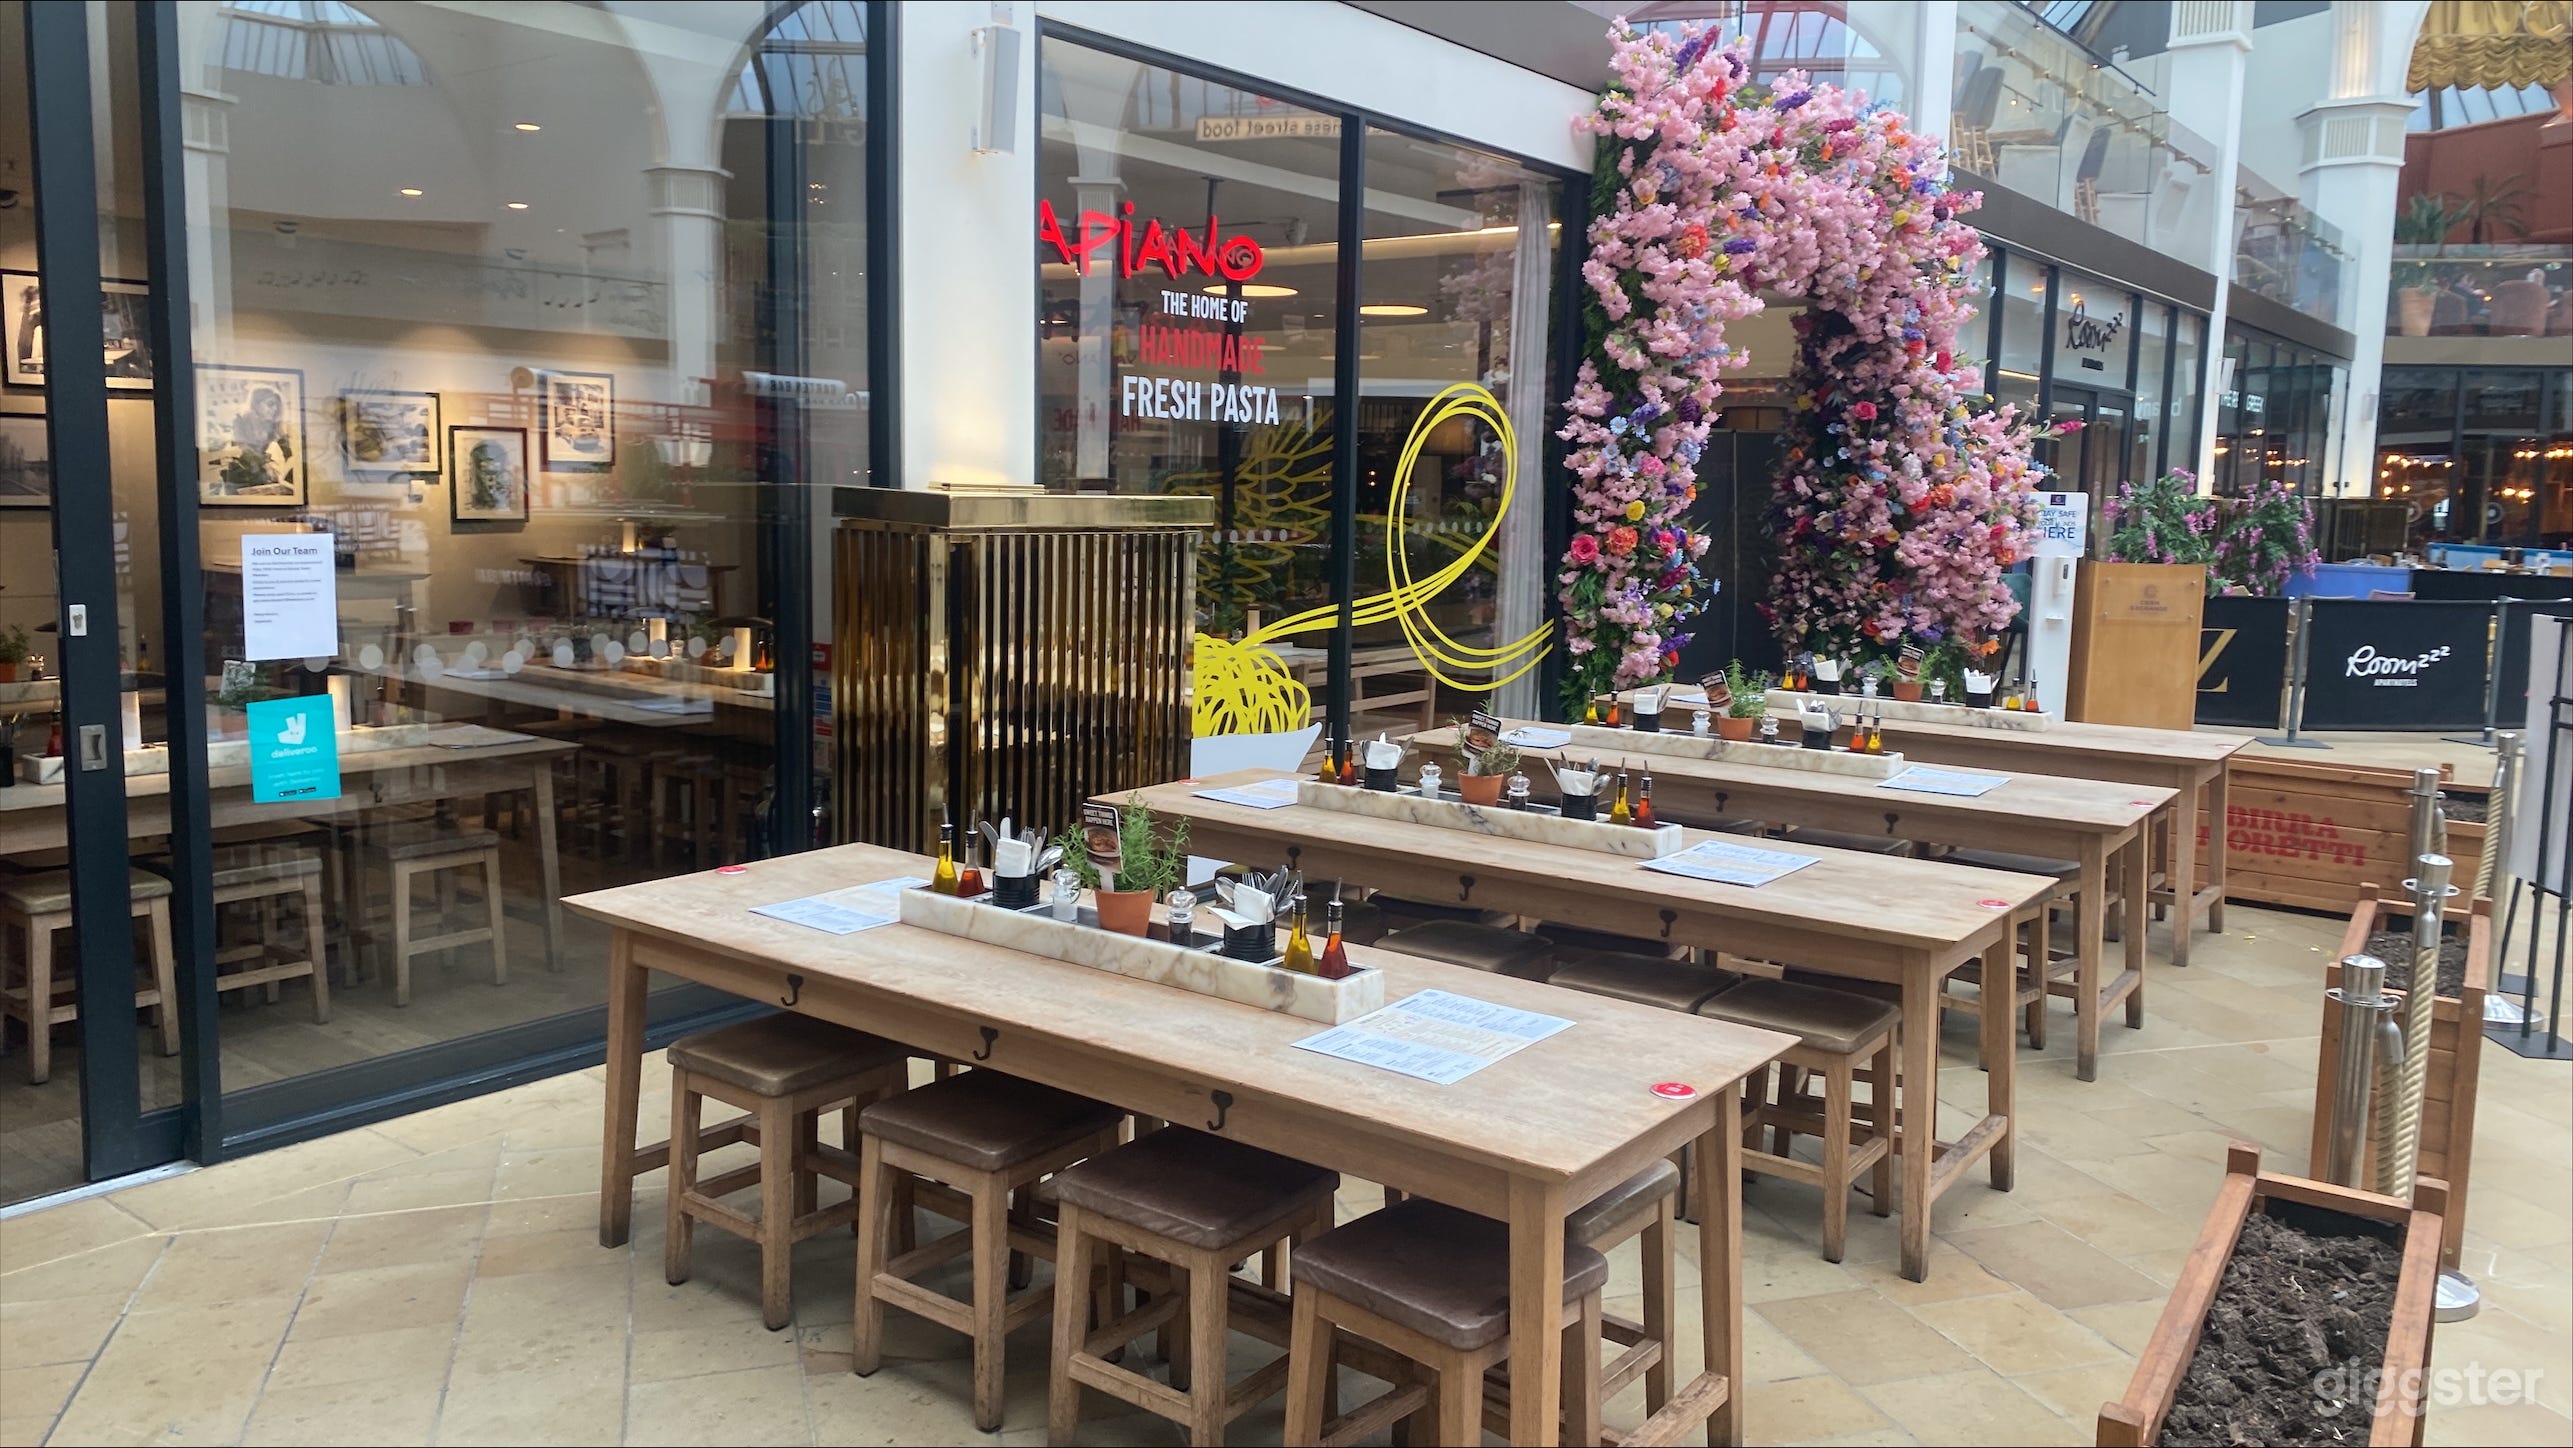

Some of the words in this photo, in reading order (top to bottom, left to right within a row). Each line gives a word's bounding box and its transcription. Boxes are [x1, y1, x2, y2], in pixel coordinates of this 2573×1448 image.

[1161, 290, 1188, 316] THE
[1191, 297, 1228, 321] HOME
[1230, 300, 1249, 324] OF
[1140, 324, 1266, 374] HANDMADE
[1122, 375, 1201, 421] FRESH
[1210, 382, 1280, 426] PASTA
[251, 547, 271, 556] Join
[273, 547, 291, 556] Our
[292, 546, 318, 555] Team
[271, 746, 318, 759] deliveroo
[2227, 804, 2340, 839] BIRRA
